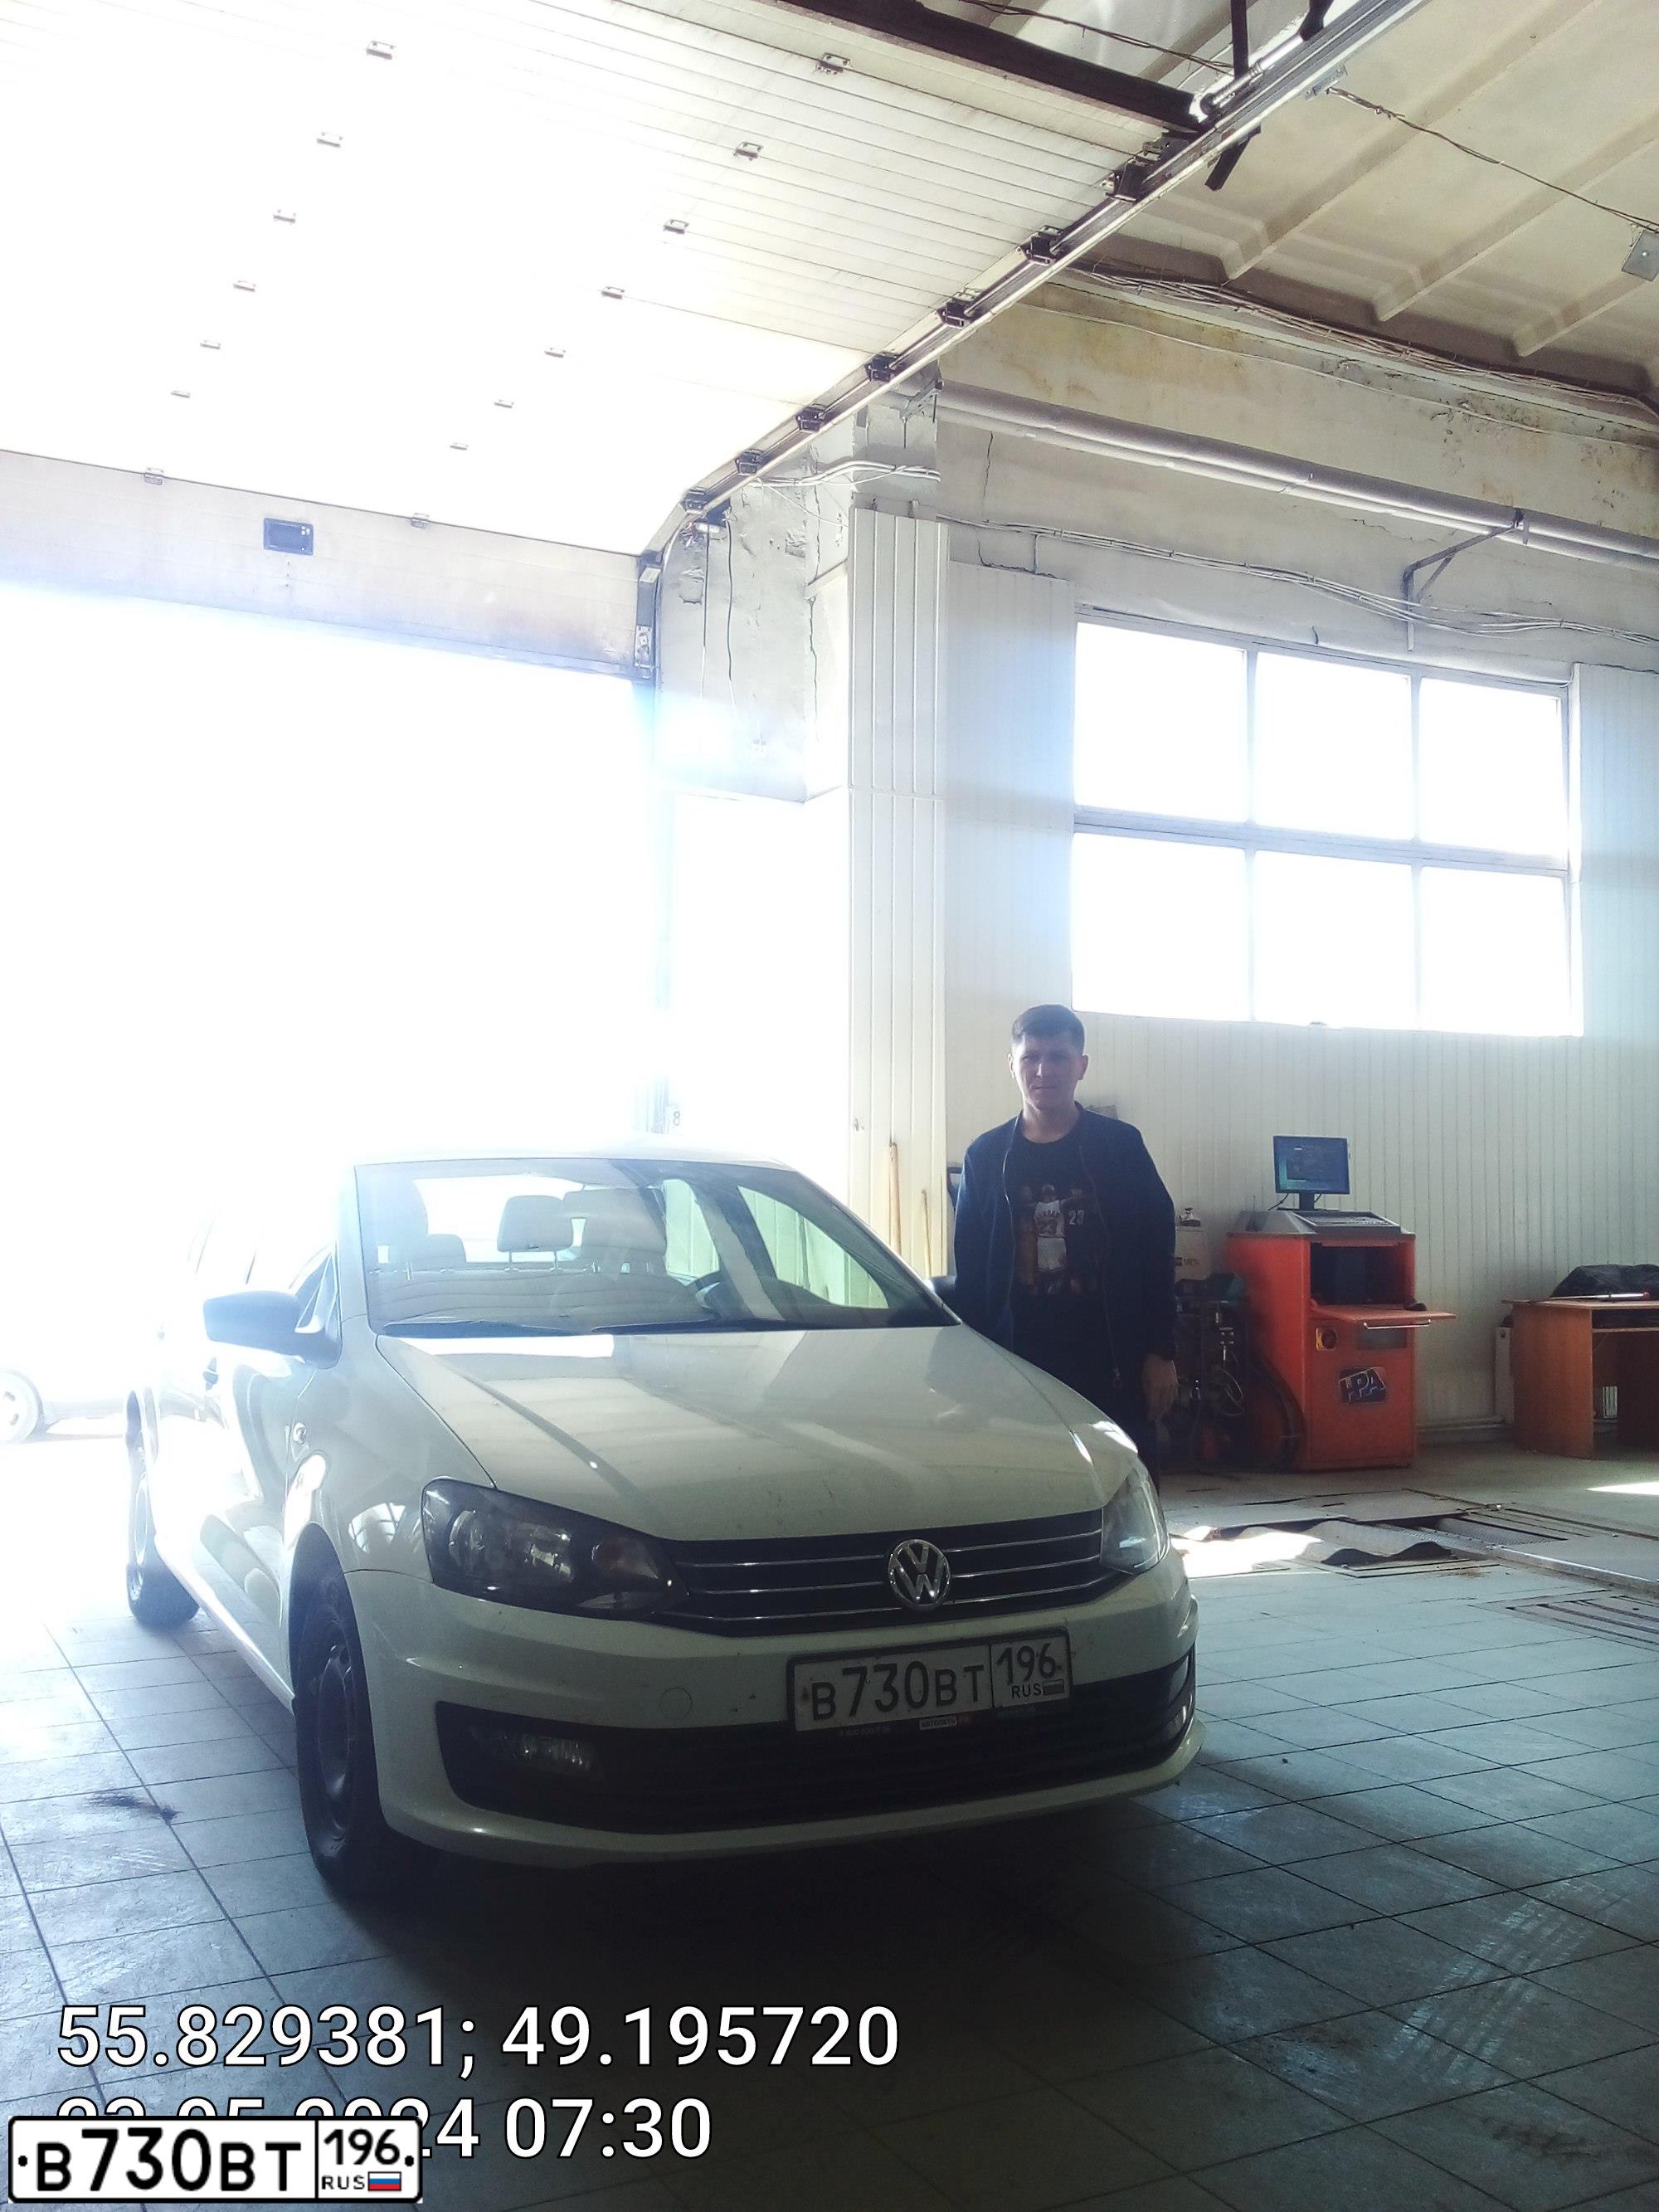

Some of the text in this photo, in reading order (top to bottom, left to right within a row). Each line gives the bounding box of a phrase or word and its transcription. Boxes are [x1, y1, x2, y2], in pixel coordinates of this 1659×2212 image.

[996, 1643, 1057, 1685] 196
[811, 1660, 984, 1721] В730ВТ
[1011, 1683, 1042, 1698] RUS
